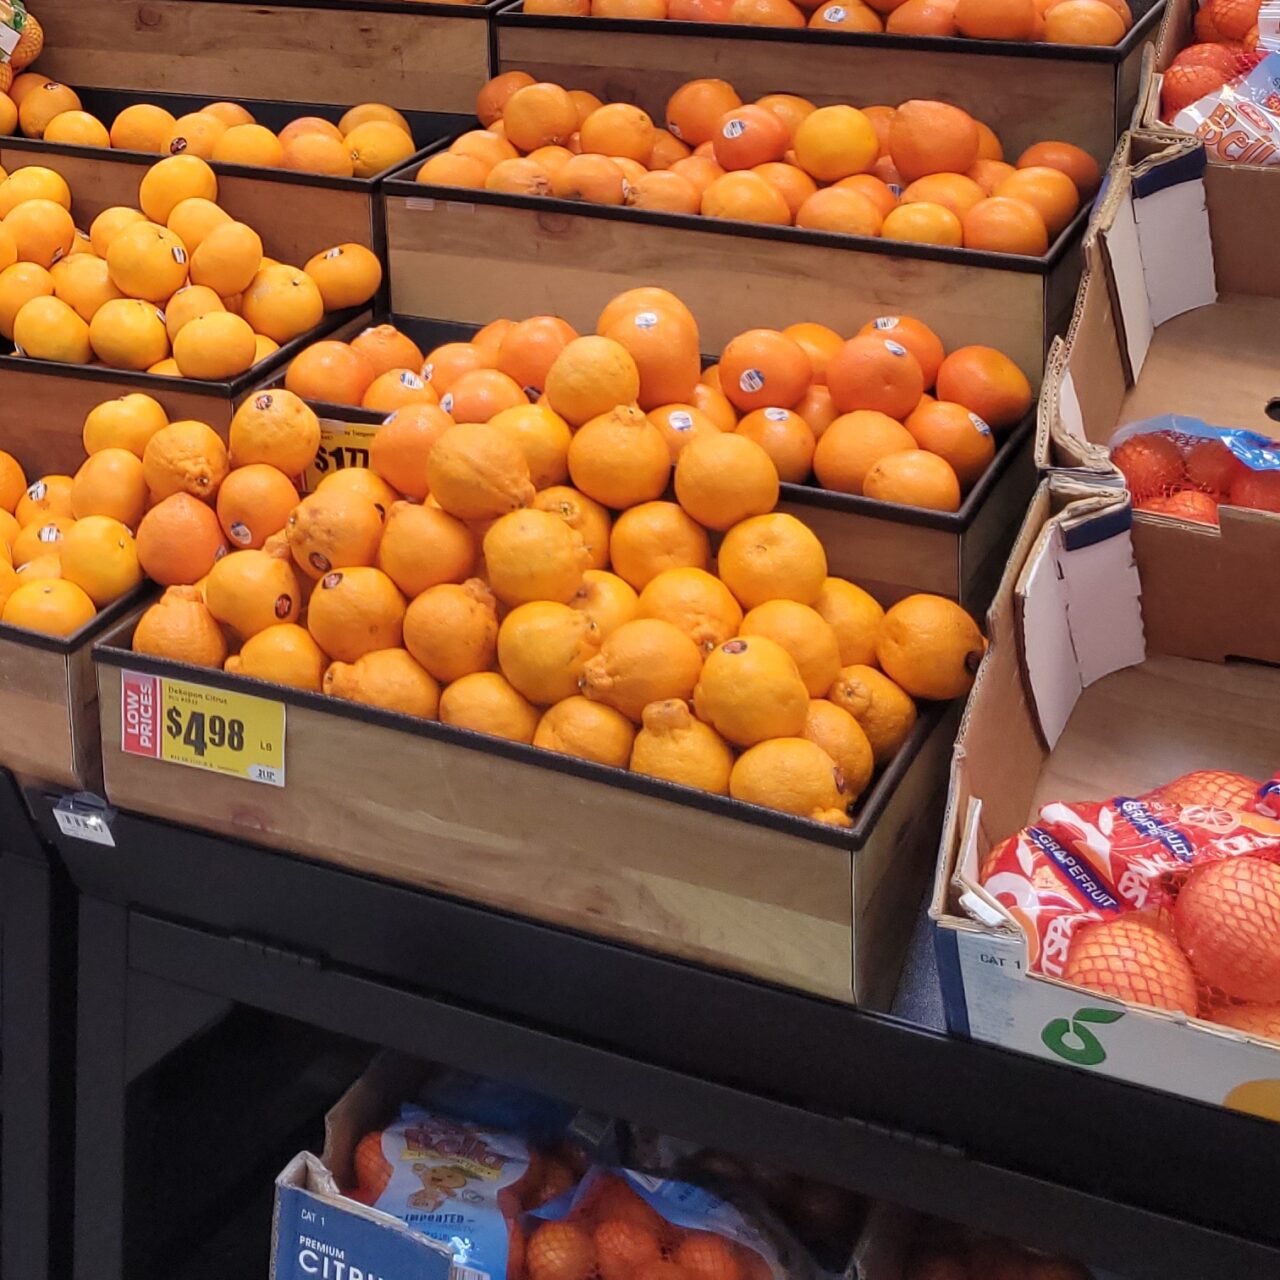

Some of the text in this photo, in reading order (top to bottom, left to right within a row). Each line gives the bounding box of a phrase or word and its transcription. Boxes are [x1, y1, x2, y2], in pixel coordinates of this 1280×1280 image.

[127, 691, 139, 735] LOW
[140, 683, 152, 749] PRICES
[260, 741, 272, 751] LB
[1039, 833, 1117, 908] GRAPEFRUIT
[980, 954, 1020, 969] CAT 1
[301, 1208, 316, 1223] CAT
[299, 1235, 345, 1259] PREMIUM
